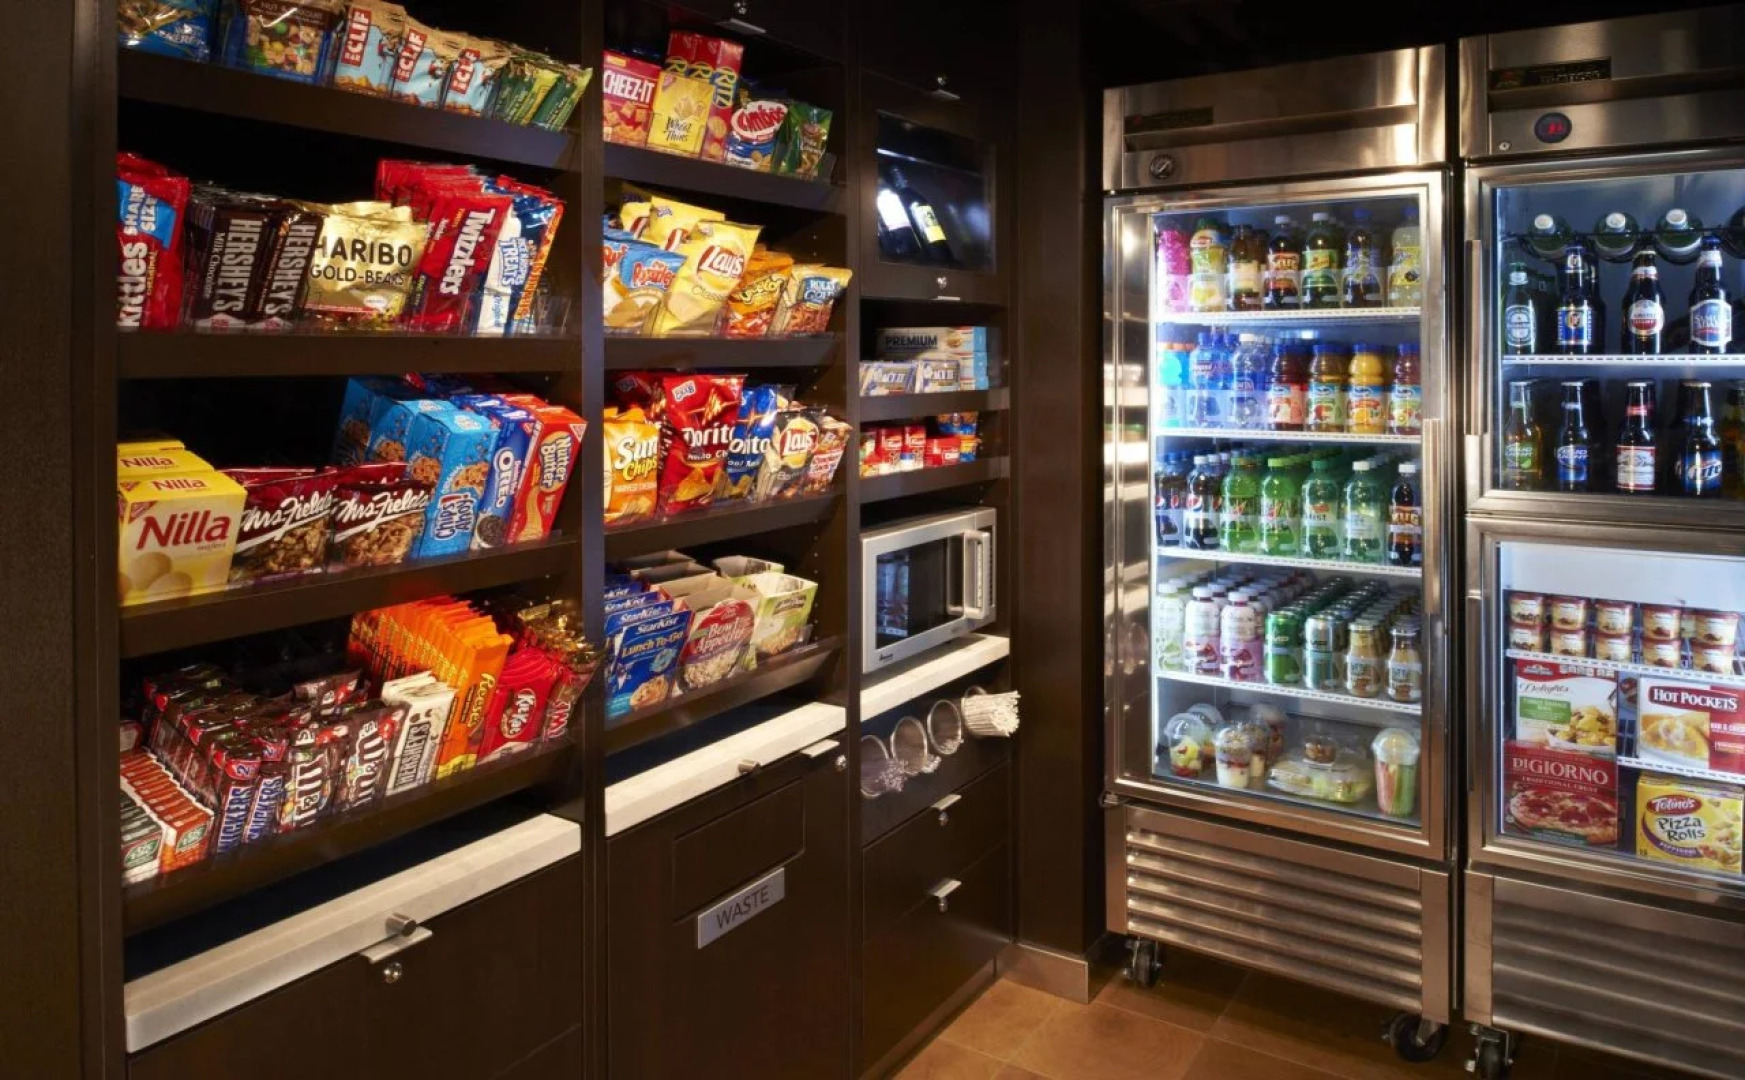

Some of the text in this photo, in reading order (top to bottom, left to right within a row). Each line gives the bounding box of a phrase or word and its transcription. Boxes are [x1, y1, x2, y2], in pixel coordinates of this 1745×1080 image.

[346, 10, 371, 53] CLIF
[123, 185, 146, 237] SHARE
[212, 218, 263, 312] HERSHEY'S
[264, 223, 317, 315] HERSHEY'S
[439, 207, 497, 297] Twizzlers
[700, 244, 745, 280] Lay's
[885, 334, 938, 346] PREMIUM
[120, 454, 175, 468] Nilla
[495, 449, 515, 509] OREO
[540, 442, 558, 494] Butter
[554, 434, 573, 485] Nutter
[622, 456, 658, 481] Chips
[151, 477, 208, 491] Nilla
[135, 509, 231, 551] Nilla
[622, 638, 655, 659] Lunch
[1653, 688, 1739, 712] HOT POCKETS
[397, 722, 431, 788] HERSHEY'S
[1650, 797, 1697, 812] Totino's
[1657, 816, 1703, 830] Pizza
[1664, 829, 1706, 842] Rolls
[717, 884, 770, 930] WASTE
